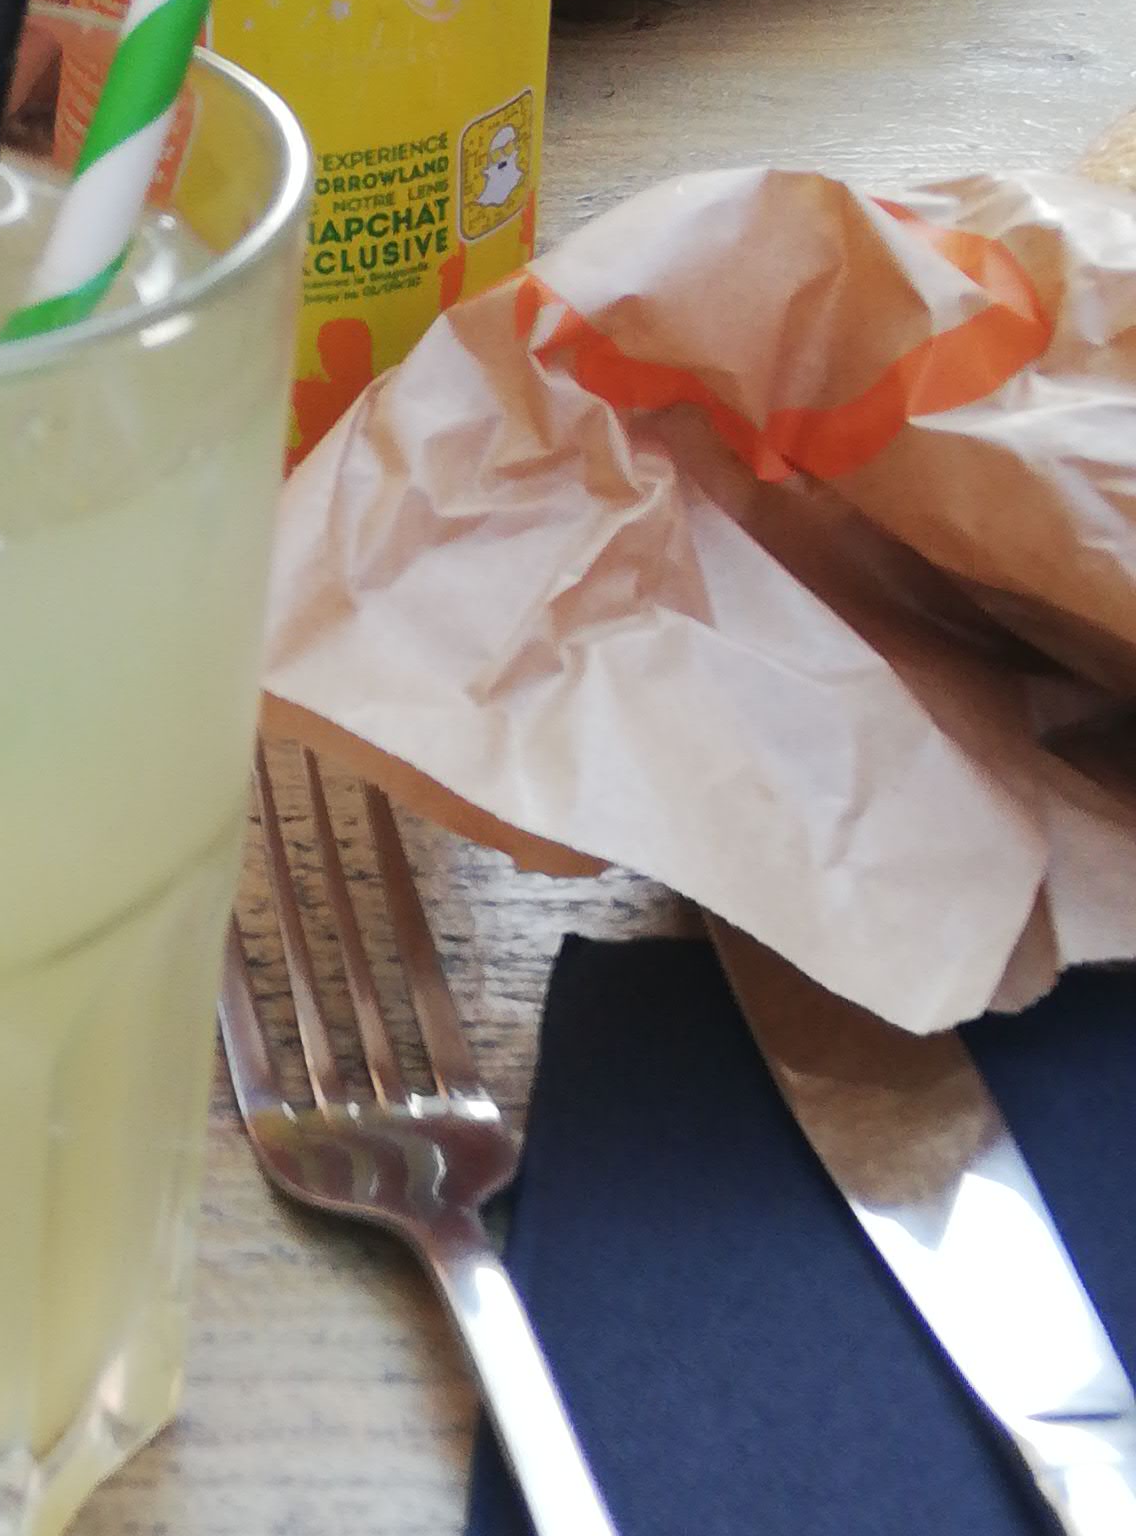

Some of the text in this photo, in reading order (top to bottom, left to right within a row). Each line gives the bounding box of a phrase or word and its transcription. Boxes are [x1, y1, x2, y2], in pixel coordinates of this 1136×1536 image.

[317, 131, 449, 172] 'EXPERIENCE
[314, 156, 449, 195] ORROWLAND
[309, 197, 450, 244] APCHAT
[304, 226, 449, 275] CLUSIVE
